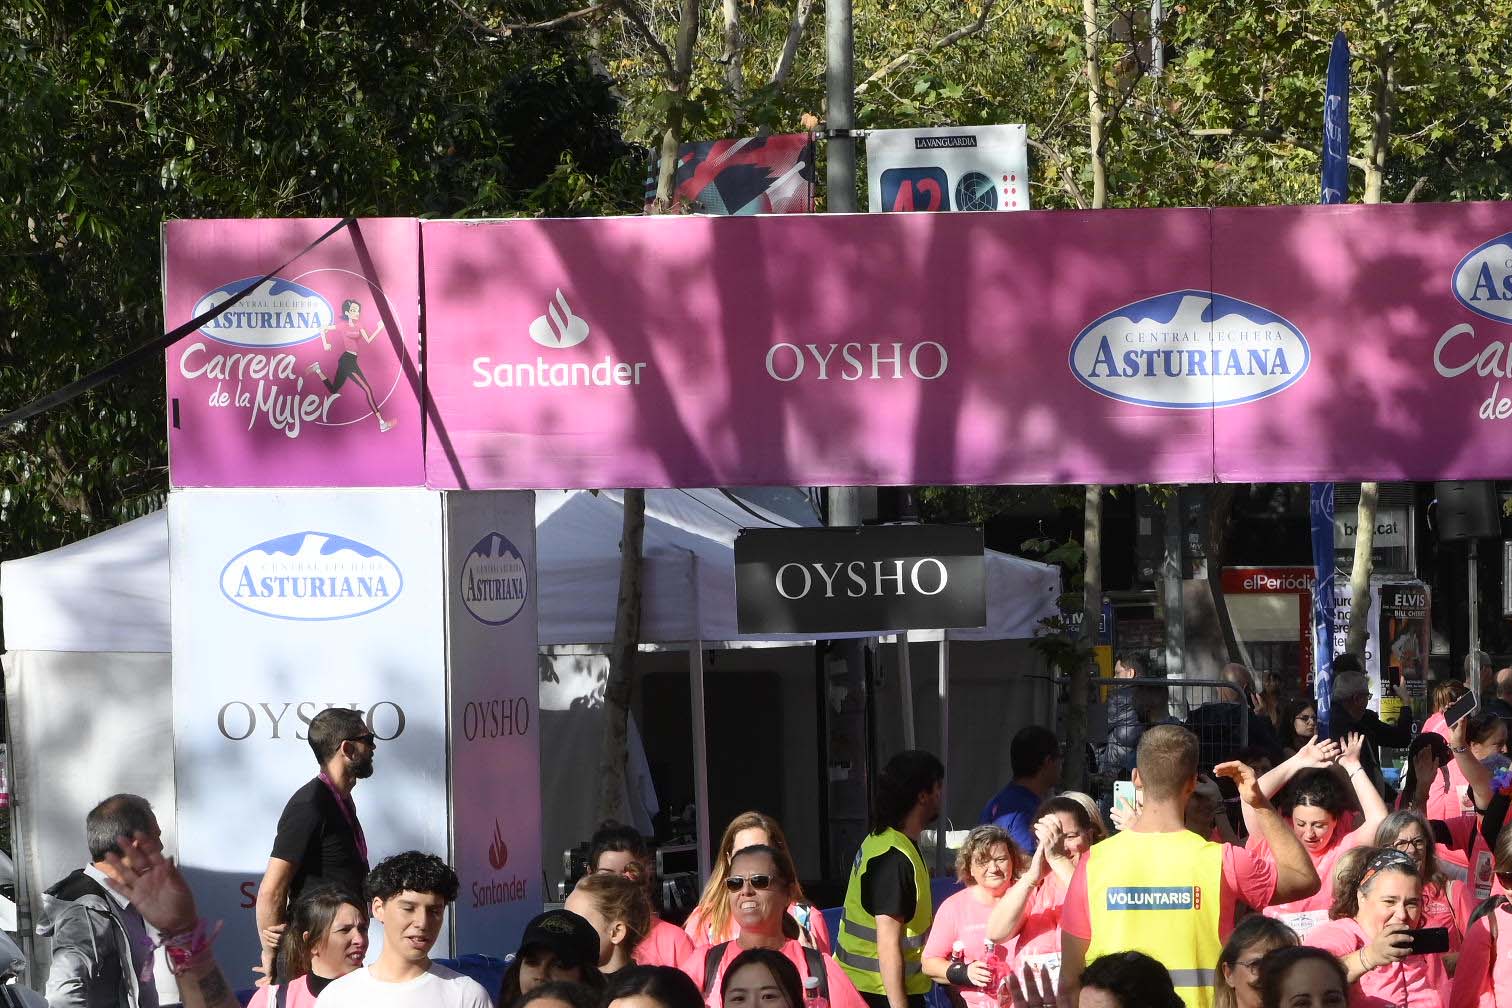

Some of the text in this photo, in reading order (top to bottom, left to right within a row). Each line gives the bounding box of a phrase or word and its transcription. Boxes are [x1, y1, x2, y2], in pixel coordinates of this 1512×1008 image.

[202, 302, 323, 329] ASTURIANA
[1125, 330, 1283, 343] CENTRAL LECHERA
[180, 342, 297, 380] Carrera
[473, 356, 646, 389] Santander
[765, 341, 949, 382] OYSHO
[1088, 335, 1291, 378] ASTURIANA
[209, 377, 341, 439] de la Mujer
[1479, 380, 1512, 420] de
[235, 564, 390, 598] ASTURIANA
[466, 577, 525, 603] ASTURIANA
[775, 558, 949, 600] OYSHO
[1395, 594, 1425, 606] ELVIS
[464, 697, 530, 742] OYSHO
[471, 877, 528, 908] Santander
[1108, 891, 1191, 906] VOLUNTARIS
